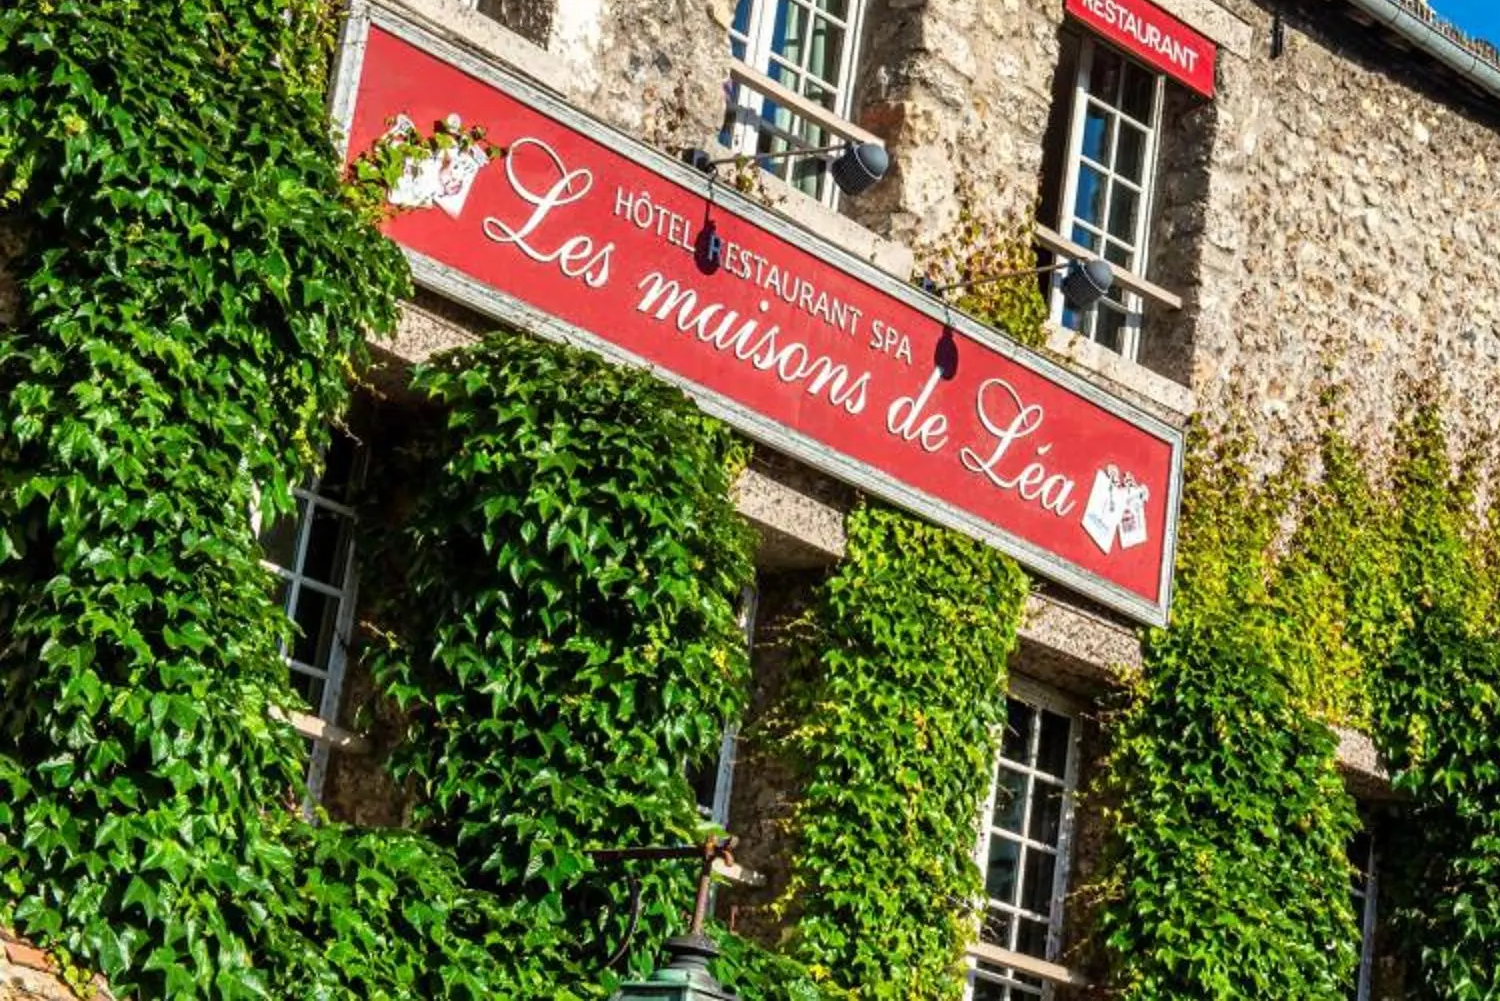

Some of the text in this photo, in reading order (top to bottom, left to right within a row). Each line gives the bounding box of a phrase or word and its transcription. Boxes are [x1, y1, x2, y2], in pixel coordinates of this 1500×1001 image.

[482, 137, 1076, 517] Les maisons de Léa
[614, 186, 912, 365] HÔTEL RESTAURANT SPA
